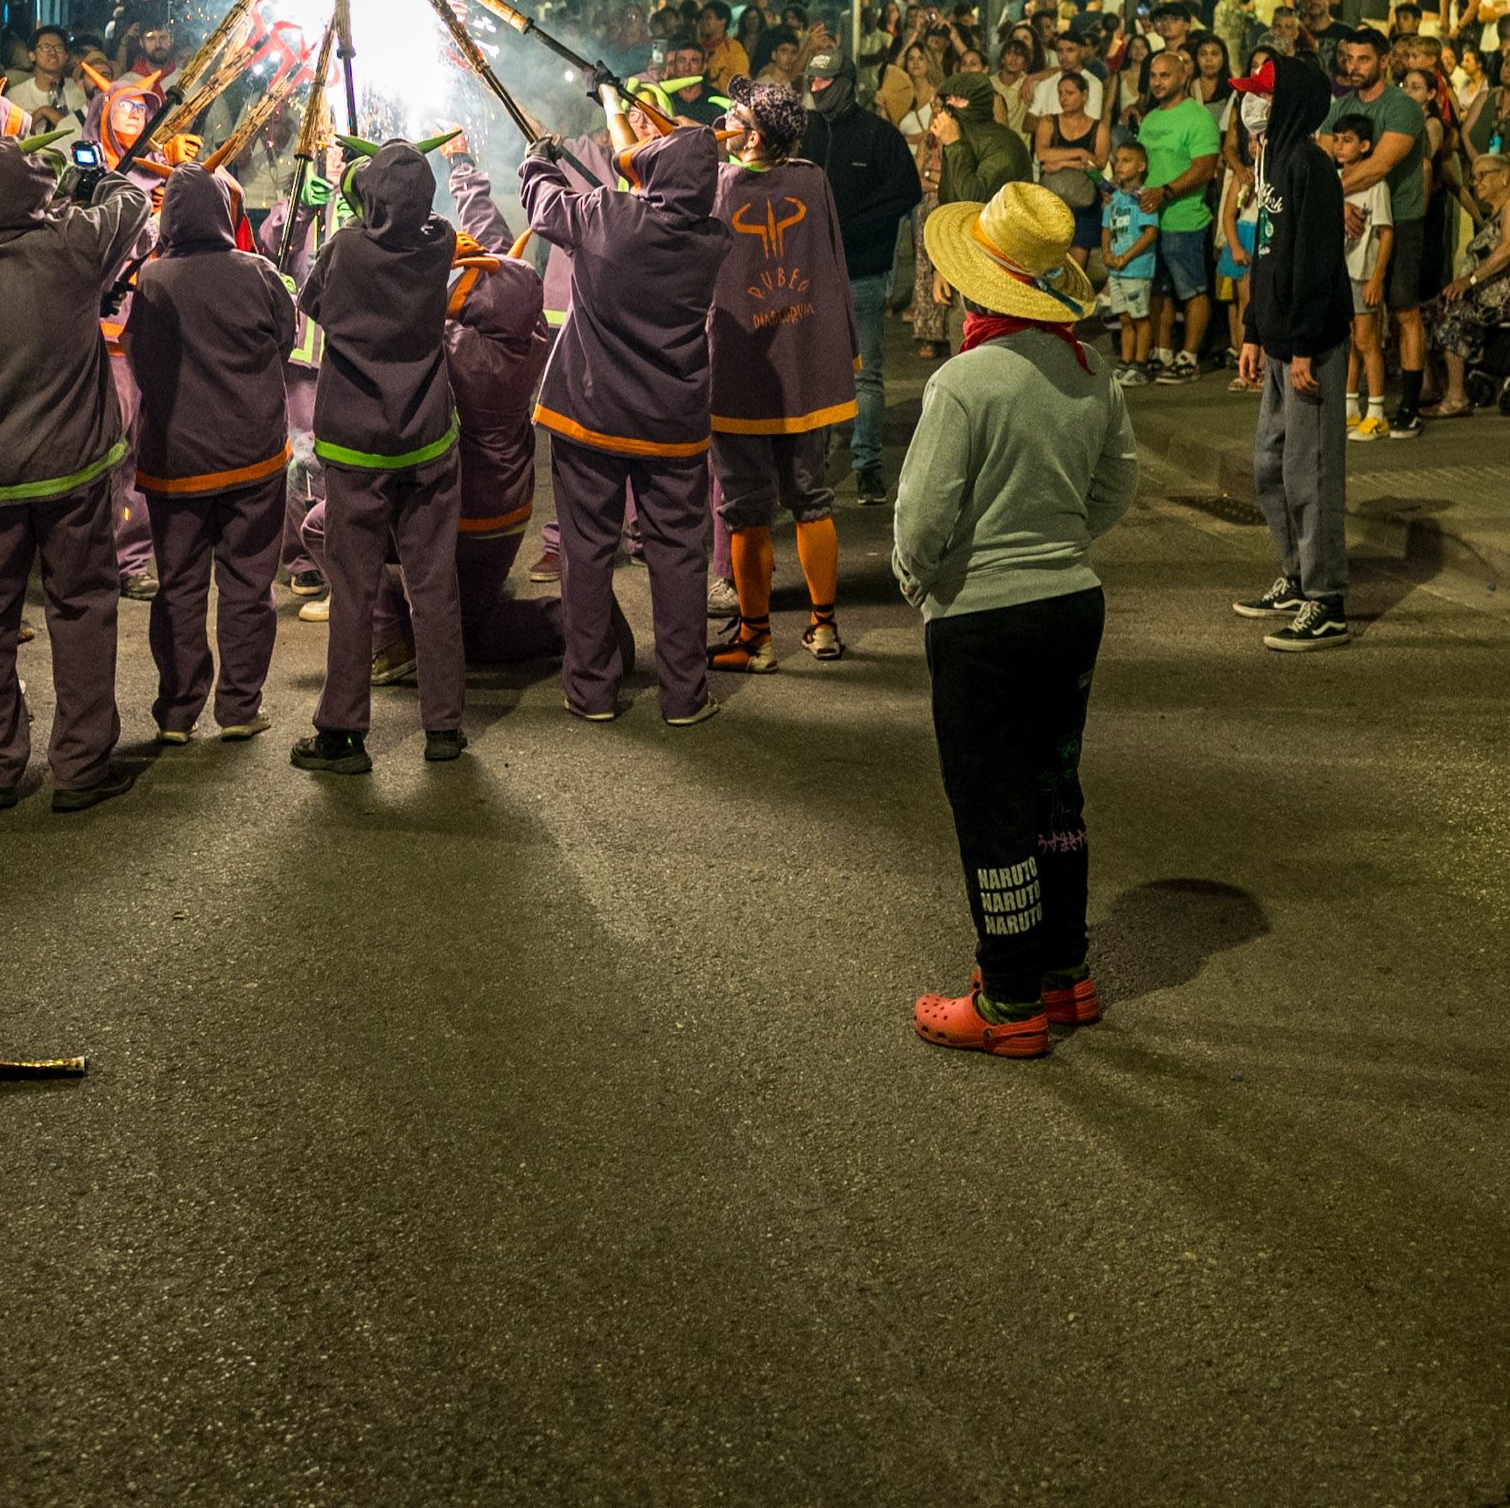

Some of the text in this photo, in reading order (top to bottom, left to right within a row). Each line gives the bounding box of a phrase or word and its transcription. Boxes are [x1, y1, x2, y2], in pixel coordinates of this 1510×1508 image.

[977, 856, 1038, 890] NARUTO
[981, 879, 1041, 913] NARUTO
[984, 902, 1043, 935] NARUTO
